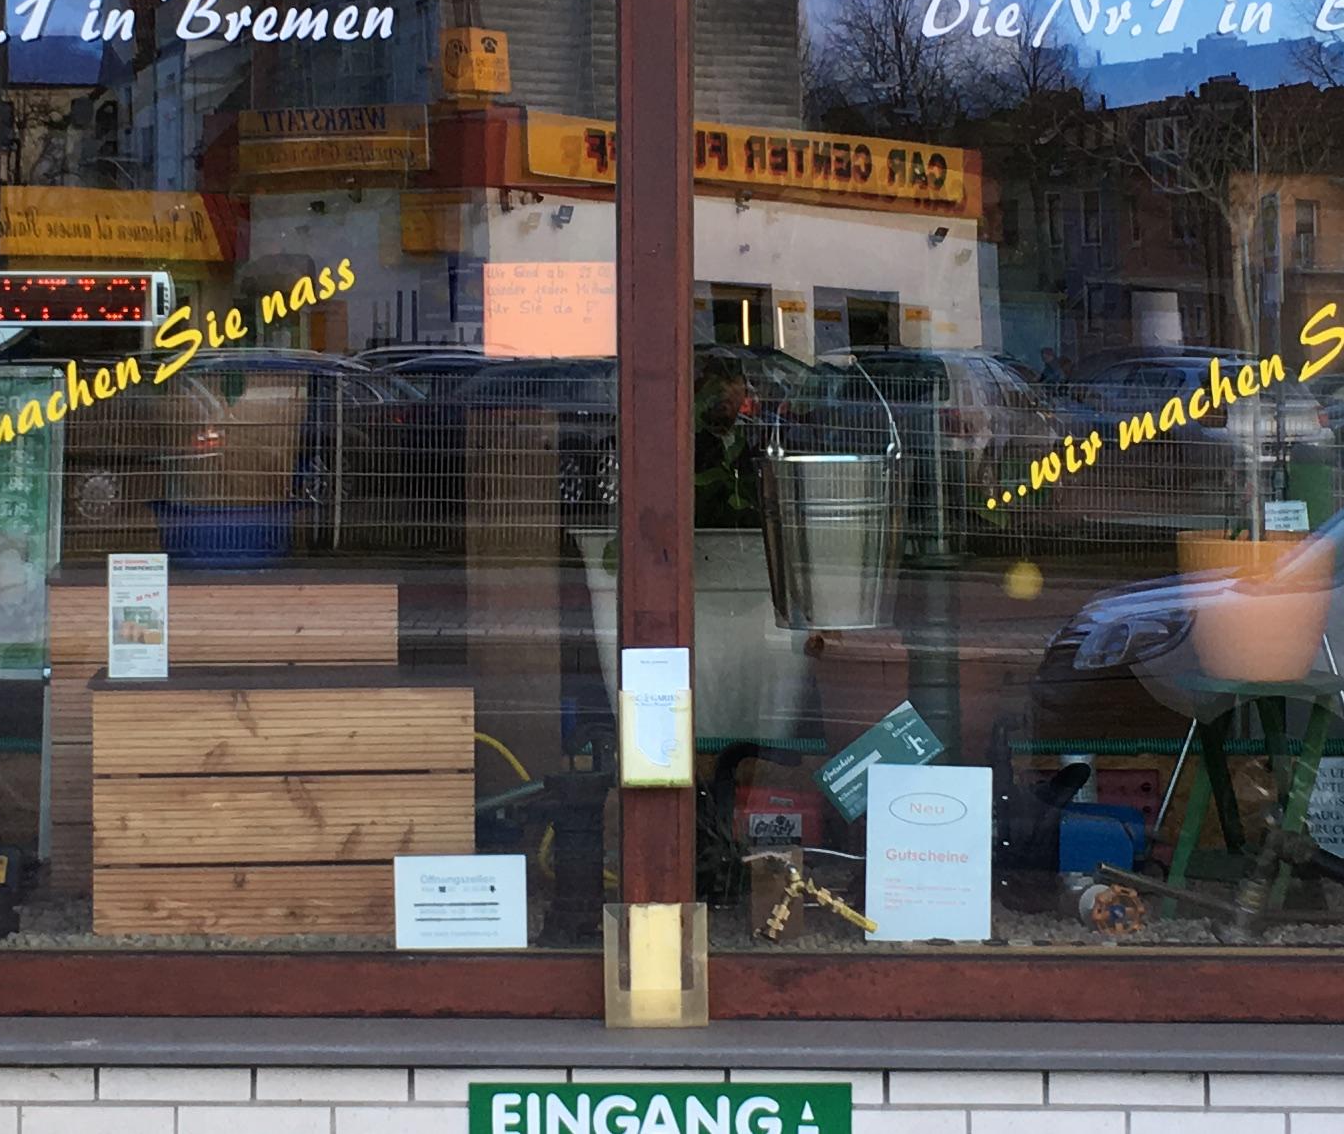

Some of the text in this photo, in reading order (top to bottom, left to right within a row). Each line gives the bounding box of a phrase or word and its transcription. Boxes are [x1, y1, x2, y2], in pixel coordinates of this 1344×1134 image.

[154, 305, 249, 385] Sie
[261, 257, 356, 327] nass
[1119, 352, 1287, 451] machen
[909, 802, 945, 816] Neu
[886, 848, 969, 864] Gutscheine
[492, 1093, 782, 1134] EINGANG
